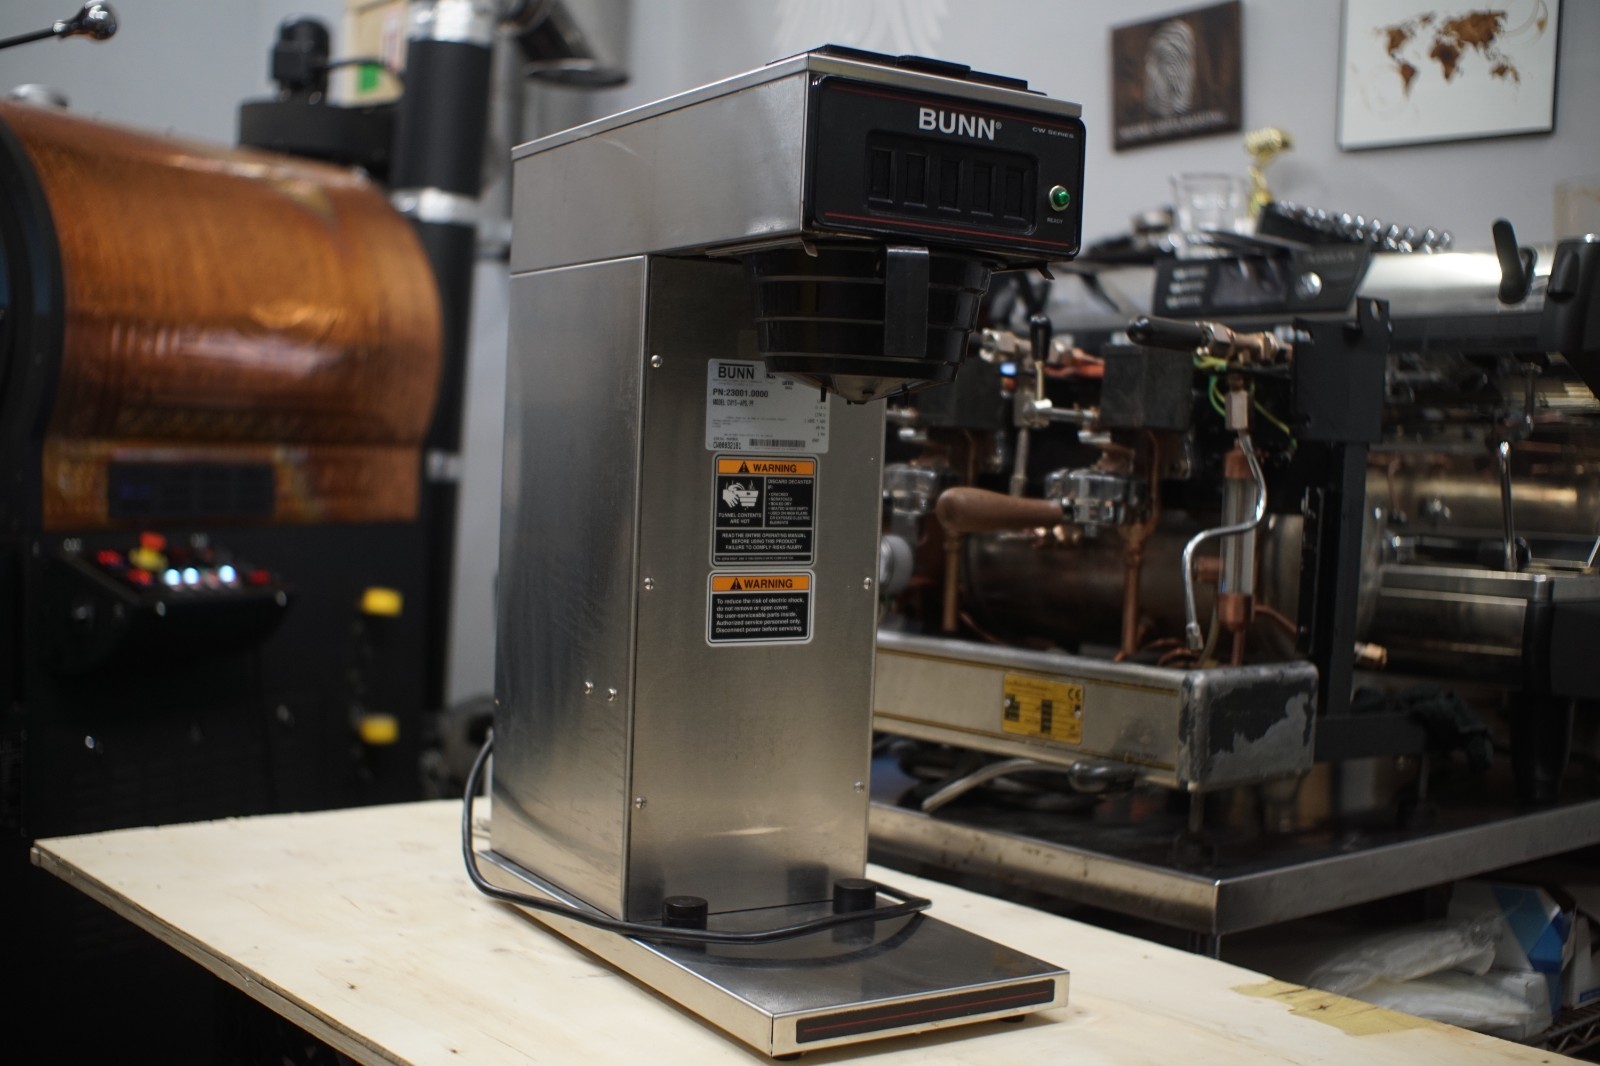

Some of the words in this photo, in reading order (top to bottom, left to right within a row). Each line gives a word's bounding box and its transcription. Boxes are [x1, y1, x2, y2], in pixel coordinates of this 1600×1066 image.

[1047, 129, 1074, 139] SERIES
[1046, 216, 1064, 224] READY
[718, 366, 754, 379] BUNN
[753, 464, 796, 473] WARNING
[744, 579, 793, 588] WARNING
